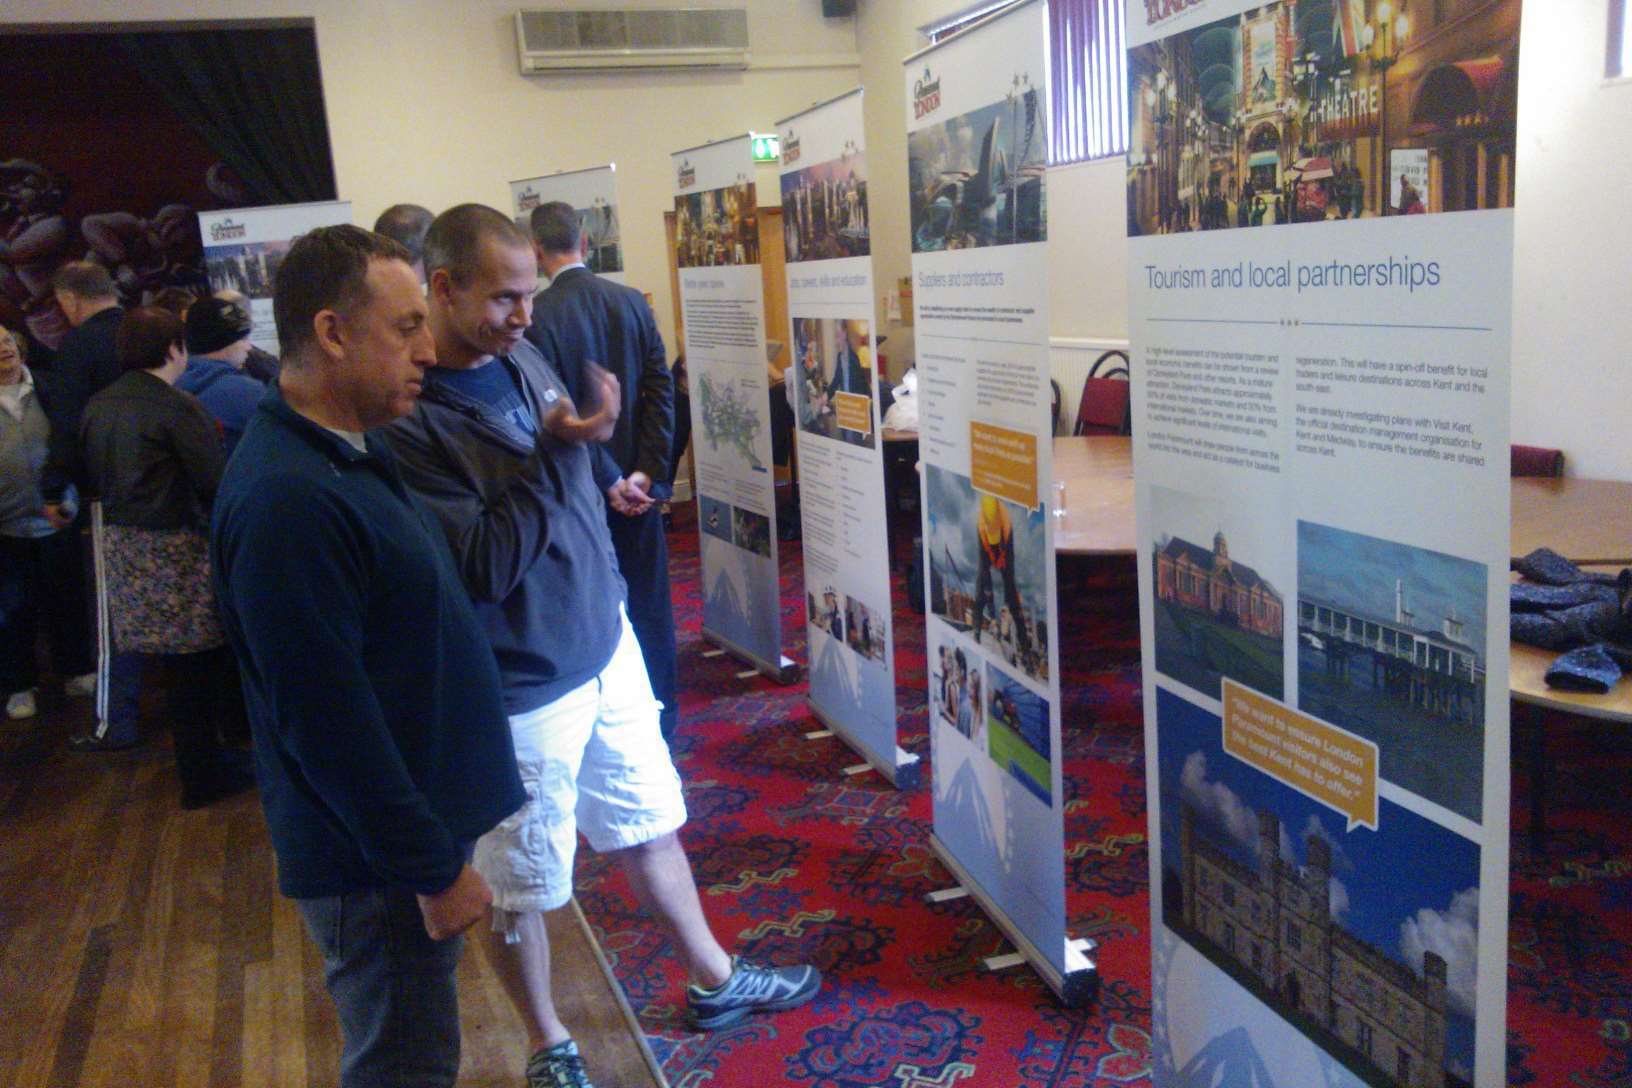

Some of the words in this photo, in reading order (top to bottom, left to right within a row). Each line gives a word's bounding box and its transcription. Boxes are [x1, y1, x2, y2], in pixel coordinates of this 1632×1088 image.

[1145, 265, 1206, 289] Tourism
[1211, 261, 1243, 288] and
[1249, 260, 1291, 288] local
[1298, 256, 1441, 293] partnerships
[1340, 358, 1355, 369] This
[1356, 359, 1368, 370] will
[1368, 359, 1386, 371] have
[1388, 363, 1394, 371] a
[1427, 363, 1455, 376] benefit
[1457, 365, 1468, 377] for
[1470, 366, 1488, 378] local
[1358, 373, 1403, 387] destinations
[1404, 379, 1432, 389] across
[1433, 379, 1453, 391] Kent
[1454, 381, 1470, 392] and
[1472, 382, 1485, 393] the
[1346, 409, 1390, 425] investigating
[1391, 414, 1412, 426] plans
[1414, 416, 1432, 428] with
[1432, 418, 1450, 430] Visit
[1370, 428, 1419, 441] management
[1471, 438, 1482, 449] for
[1394, 443, 1407, 455] the
[1409, 445, 1441, 460] benefits
[1442, 452, 1455, 462] are
[1457, 452, 1485, 466] shared
[1323, 741, 1363, 767] London
